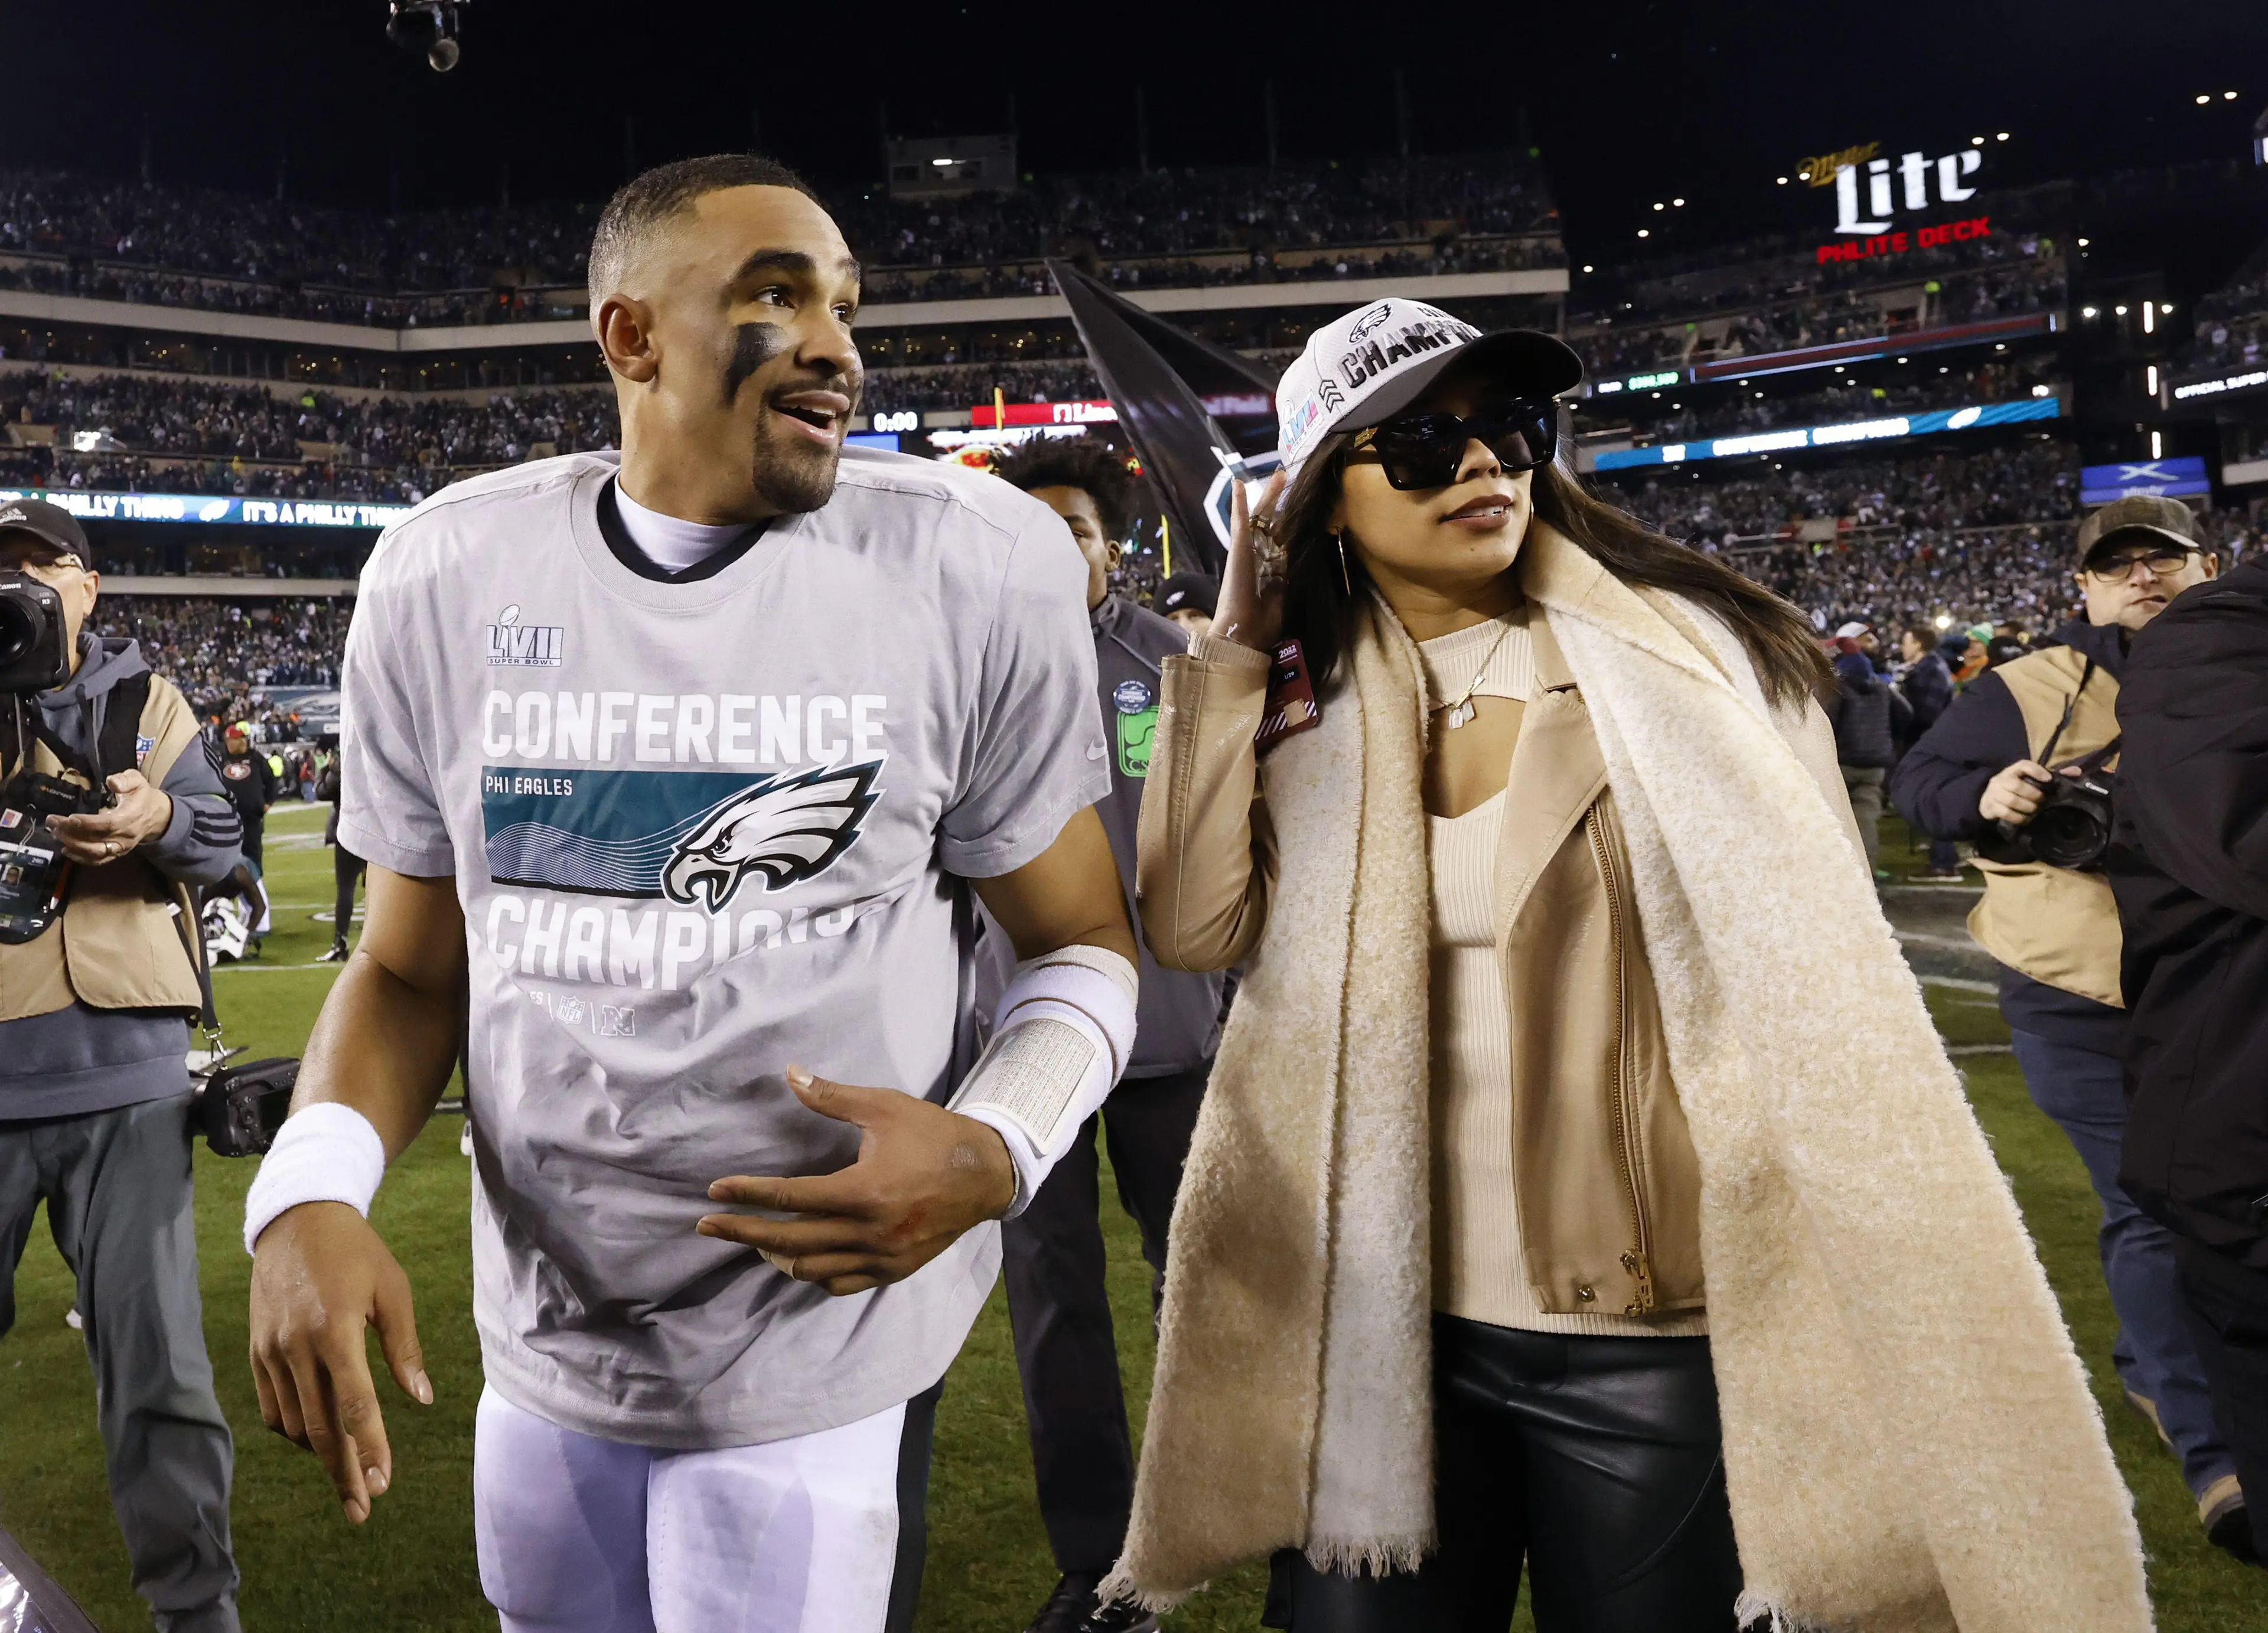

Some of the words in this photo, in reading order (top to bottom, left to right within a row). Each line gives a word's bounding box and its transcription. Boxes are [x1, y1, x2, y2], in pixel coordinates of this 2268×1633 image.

[1834, 149, 1982, 234] Lite
[1816, 232, 1909, 265] PHLITE
[1918, 216, 1991, 248] DECK
[874, 412, 918, 432] 0:00
[242, 501, 278, 523] IT'S
[279, 503, 295, 523] A
[296, 503, 357, 525] PHILLY
[486, 625, 563, 659] LVII
[1278, 644, 1297, 659] 2022
[482, 689, 887, 765] CONFERENCE
[485, 775, 509, 794] PHI
[514, 775, 573, 797] EAGLES
[561, 1006, 579, 1021] NFL
